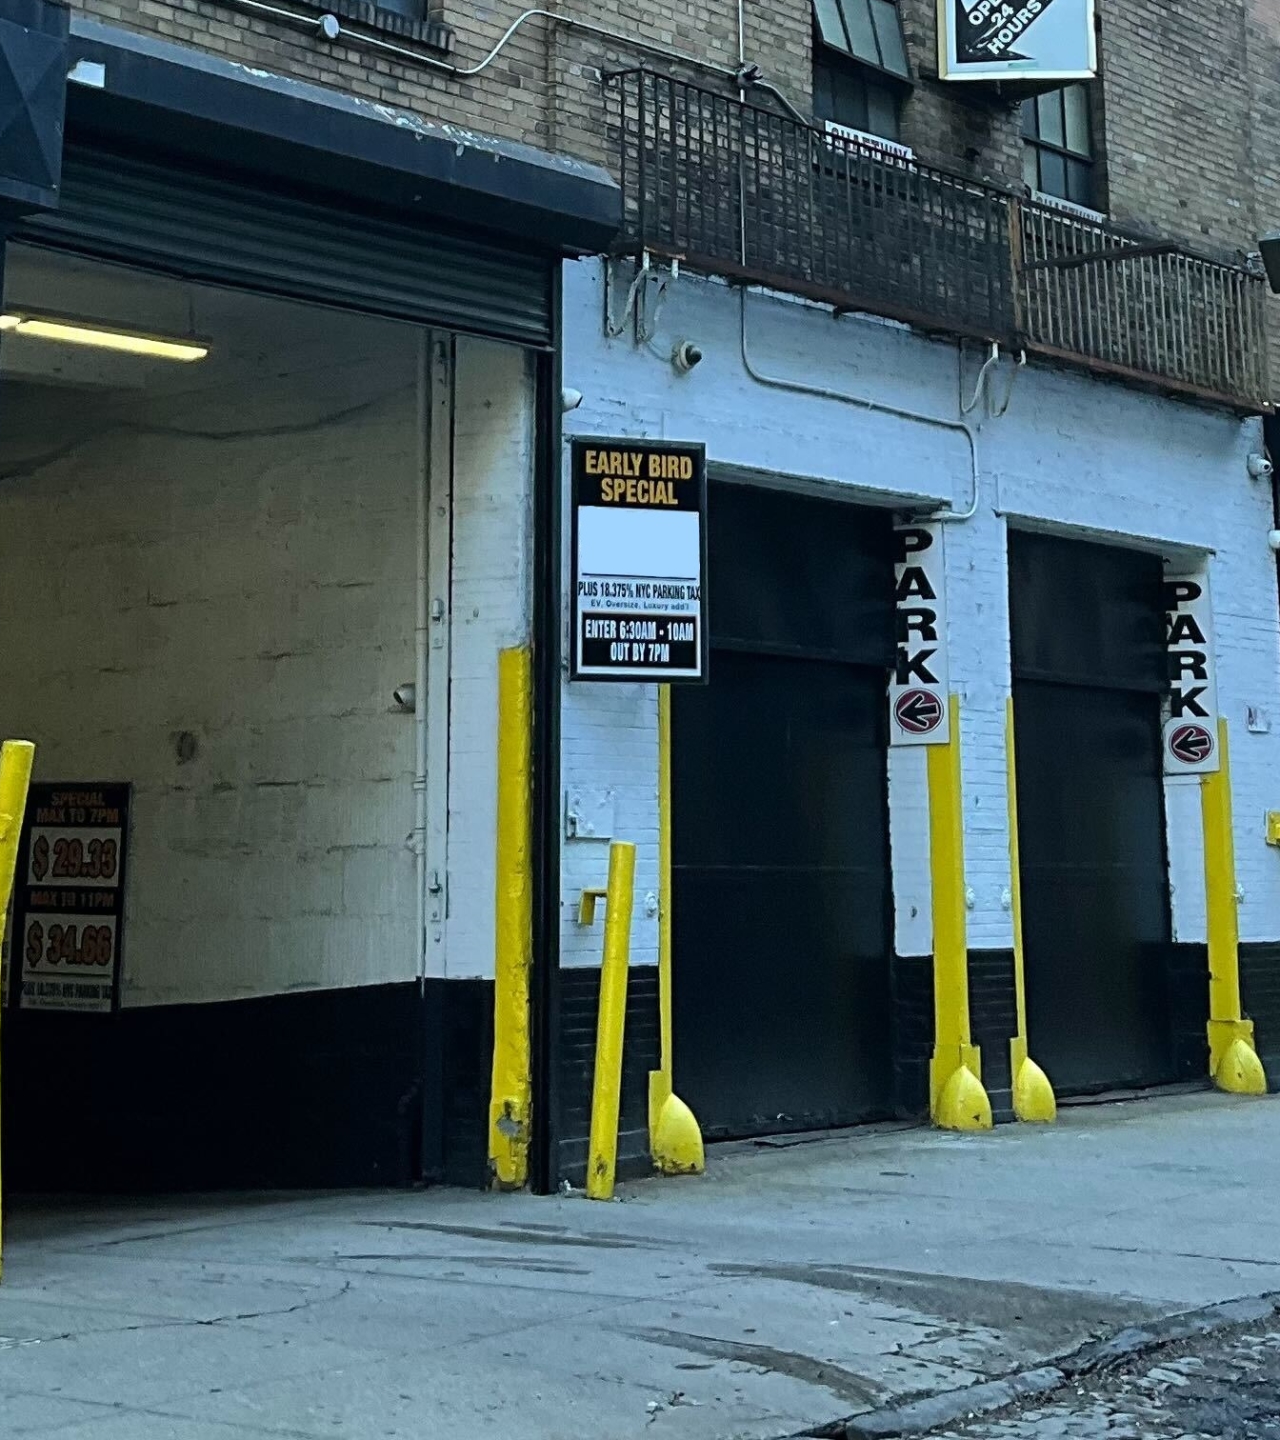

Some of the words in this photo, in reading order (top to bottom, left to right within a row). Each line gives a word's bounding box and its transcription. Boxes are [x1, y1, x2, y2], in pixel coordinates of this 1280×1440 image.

[991, 3, 1014, 27] 24
[585, 450, 643, 476] EARLY
[648, 454, 692, 480] BIRD
[601, 479, 678, 505] SPECIAL
[578, 581, 597, 597] PLUS
[600, 582, 633, 598] 18.375%
[636, 584, 651, 598] NYC
[653, 585, 685, 600] PARKING
[687, 586, 701, 601] TAX
[644, 601, 668, 611] Luxury
[893, 528, 939, 685] PARK
[585, 619, 616, 638] ENTER
[619, 621, 657, 640] 6:30AM
[667, 622, 694, 641] 10AM
[610, 642, 630, 661] OUT
[632, 642, 646, 662] BY
[648, 643, 669, 662] 7PM
[1165, 581, 1210, 718] PARK
[51, 791, 105, 807] SPECIAL
[36, 807, 66, 823] MAX
[69, 808, 86, 823] TO
[90, 808, 119, 823] 7PM
[30, 891, 57, 906] MAX
[61, 892, 77, 907] TO
[80, 893, 114, 907] 11PM
